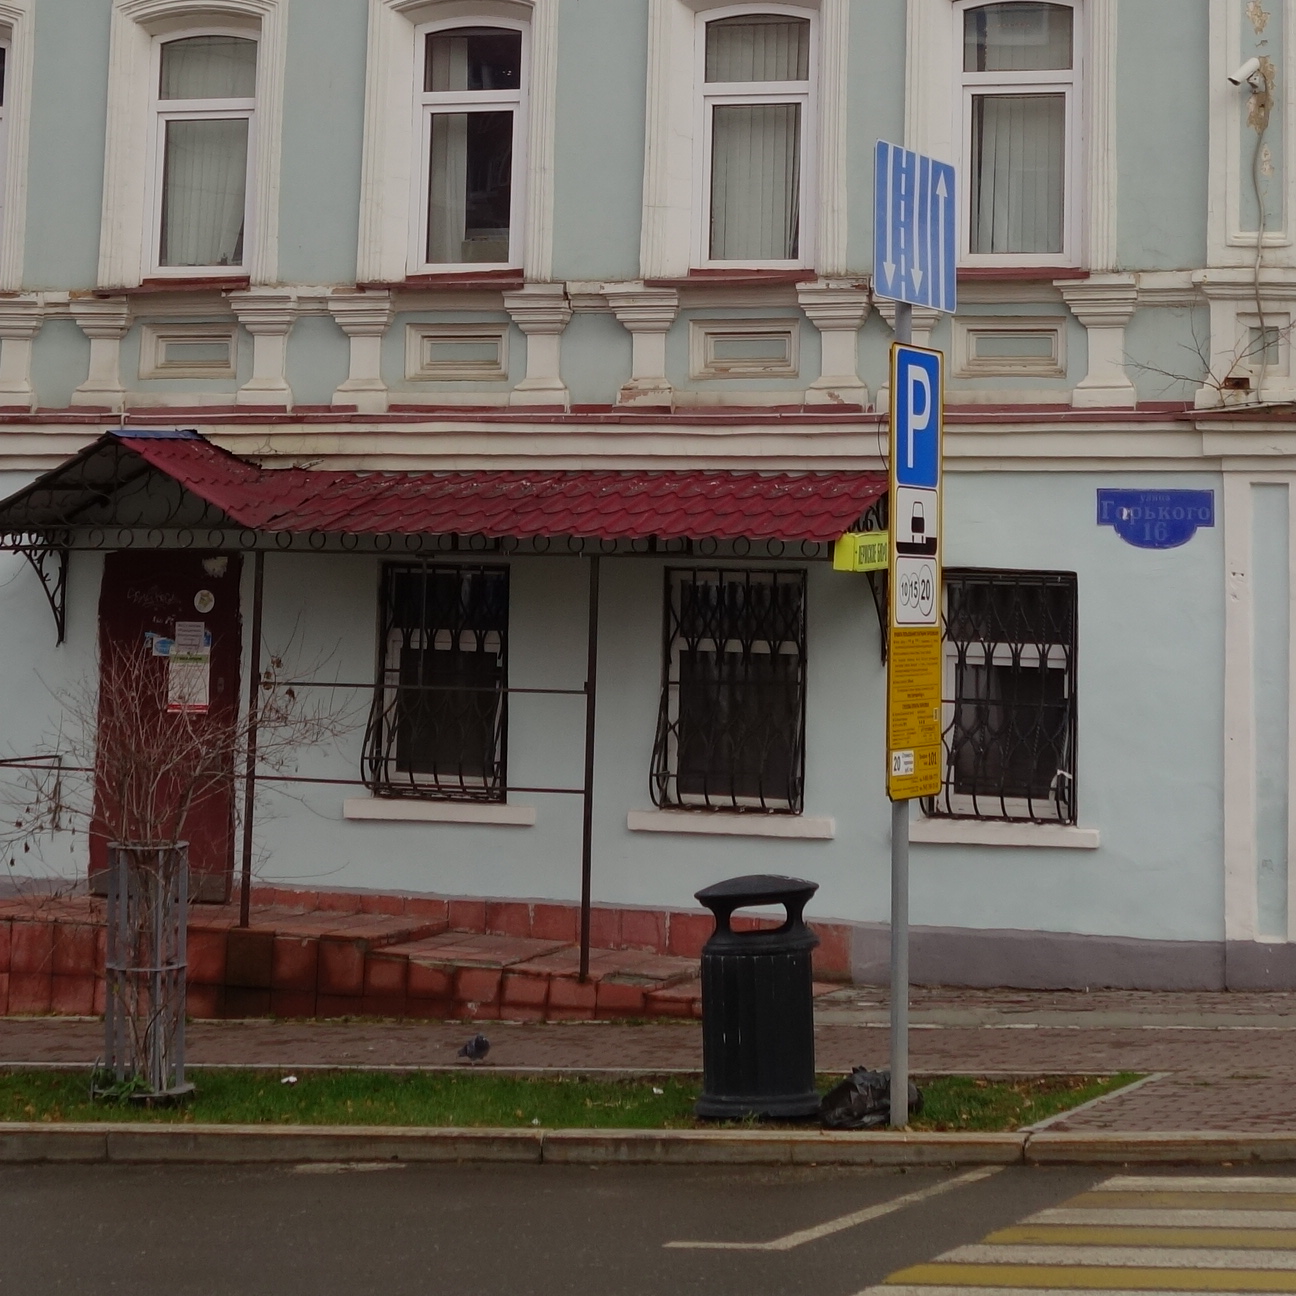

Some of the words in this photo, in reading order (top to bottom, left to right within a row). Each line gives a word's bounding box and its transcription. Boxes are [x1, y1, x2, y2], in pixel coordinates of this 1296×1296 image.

[1140, 493, 1171, 504] улица
[1100, 500, 1211, 526] Горького
[1143, 521, 1168, 541] 16
[901, 582, 908, 597] 10
[910, 582, 918, 599] 15
[920, 580, 930, 601] 20
[893, 755, 901, 772] 20
[928, 751, 937, 766] 101
